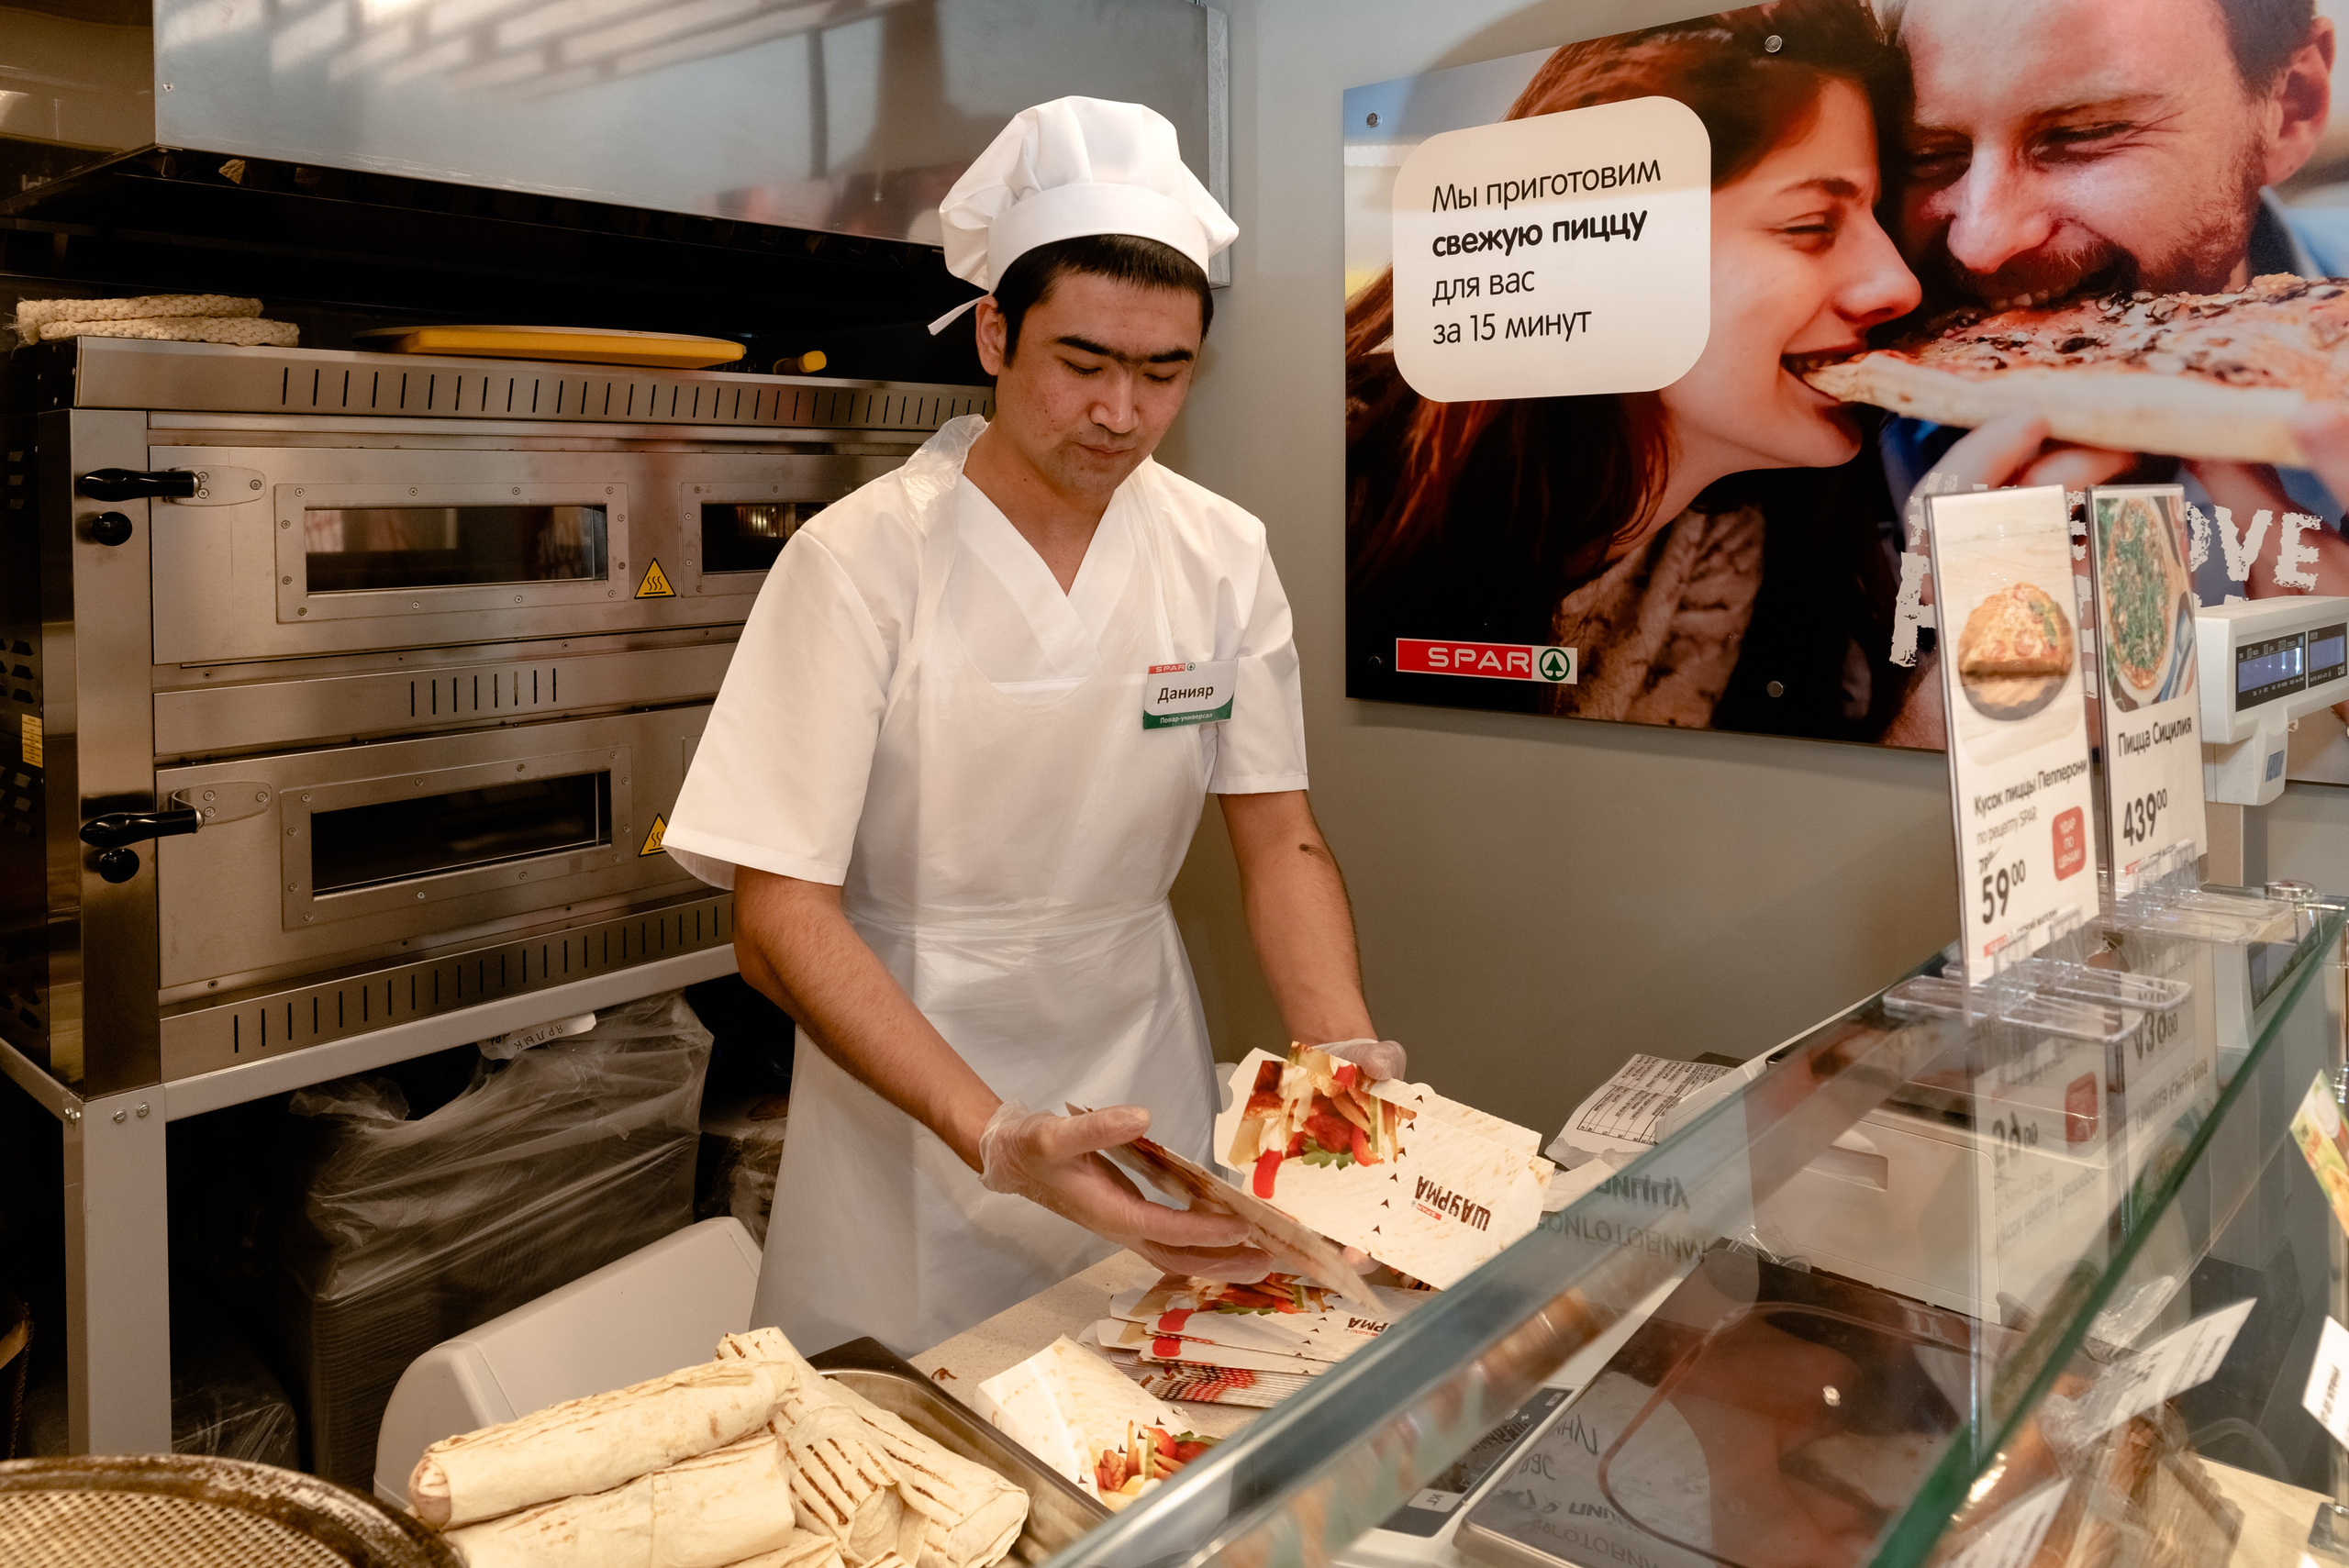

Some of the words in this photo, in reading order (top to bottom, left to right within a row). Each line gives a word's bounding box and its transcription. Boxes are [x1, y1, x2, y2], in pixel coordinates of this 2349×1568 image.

[1432, 184, 1478, 214] Мы
[1486, 159, 1662, 210] приготовим
[1431, 221, 1542, 257] свежую
[1552, 209, 1648, 243] пиццу
[1432, 276, 1480, 306] для
[1489, 269, 1535, 295] вас
[1432, 322, 1461, 344] за
[1470, 313, 1496, 342] 15
[1506, 309, 1592, 342] минут
[1155, 664, 1186, 673] SPAR
[1428, 647, 1530, 673] SPAR
[1157, 685, 1214, 704] Данияр
[1160, 713, 1213, 724] Повар-универсал
[2118, 729, 2151, 757] Пицца
[2153, 717, 2192, 744] Сицилия
[1974, 795, 2005, 818] Кусок
[2005, 778, 2036, 803] пиццы
[2038, 759, 2087, 790] Пепперони
[1977, 832, 1987, 845] по
[1989, 818, 2019, 843] рецепту
[2020, 806, 2038, 827] SPAR
[2060, 817, 2076, 835] УДАР
[2123, 792, 2156, 846] 439
[2065, 836, 2074, 851] ПО
[2058, 849, 2081, 870] ЦЕНАМ!
[1983, 868, 2009, 925] 59
[514, 1024, 563, 1051] ЯРЛЫК
[1415, 1175, 1491, 1232] ШАУРМА
[1417, 1204, 1437, 1217] SPAR
[1347, 1317, 1389, 1333] РМА
